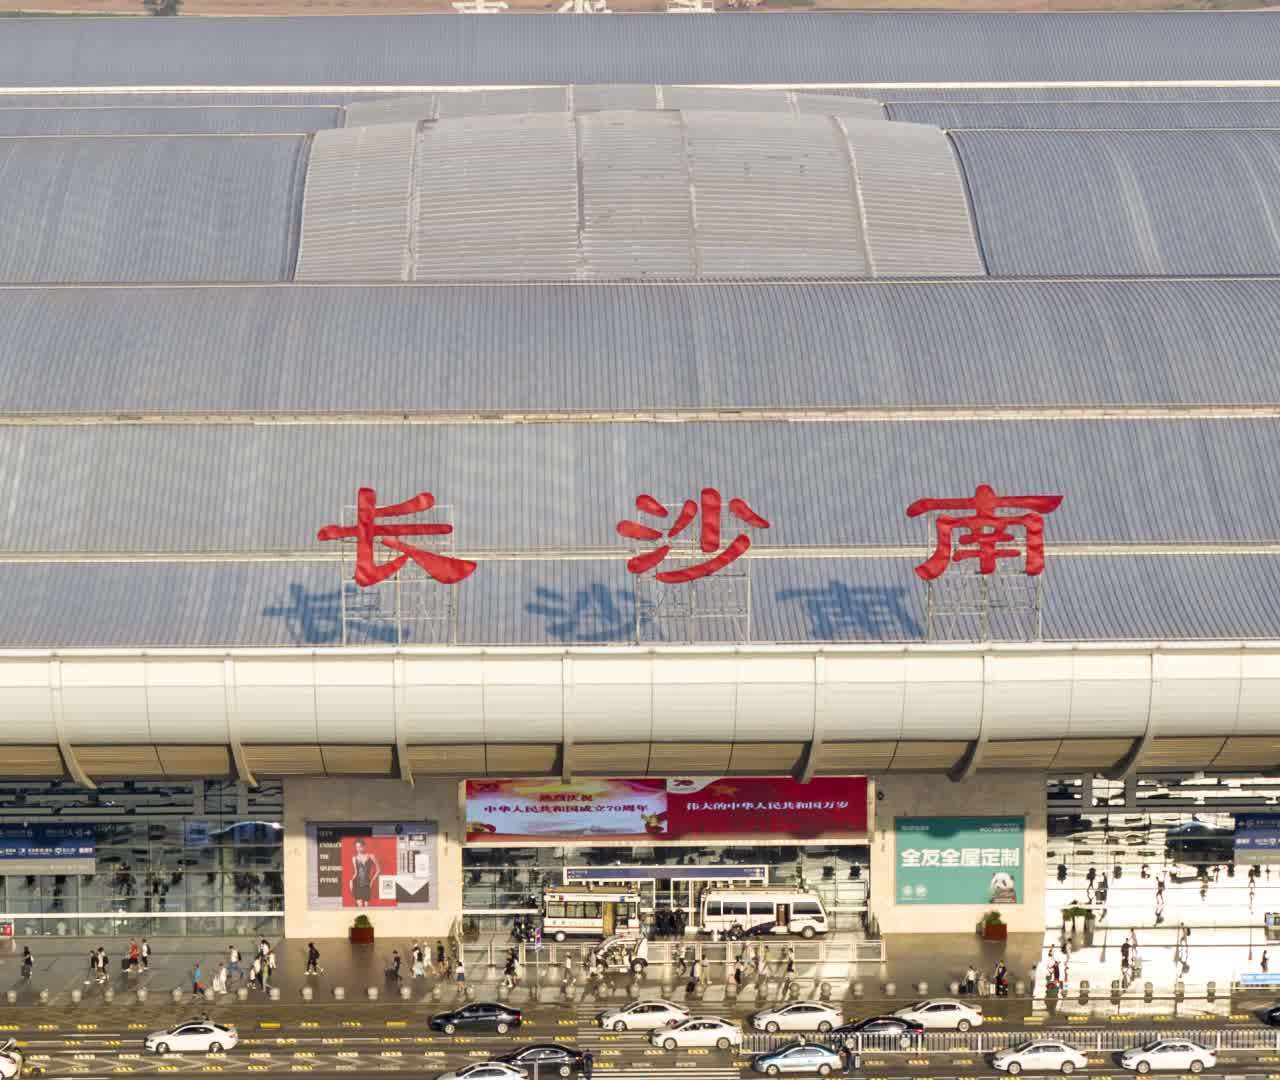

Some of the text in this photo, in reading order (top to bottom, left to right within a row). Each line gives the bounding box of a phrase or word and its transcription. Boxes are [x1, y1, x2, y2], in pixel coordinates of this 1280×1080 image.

[317, 484, 1064, 587] 长沙南
[686, 800, 849, 811] 伟大的中华人民共和国万岁
[901, 847, 1020, 867] 全友全屋定制
